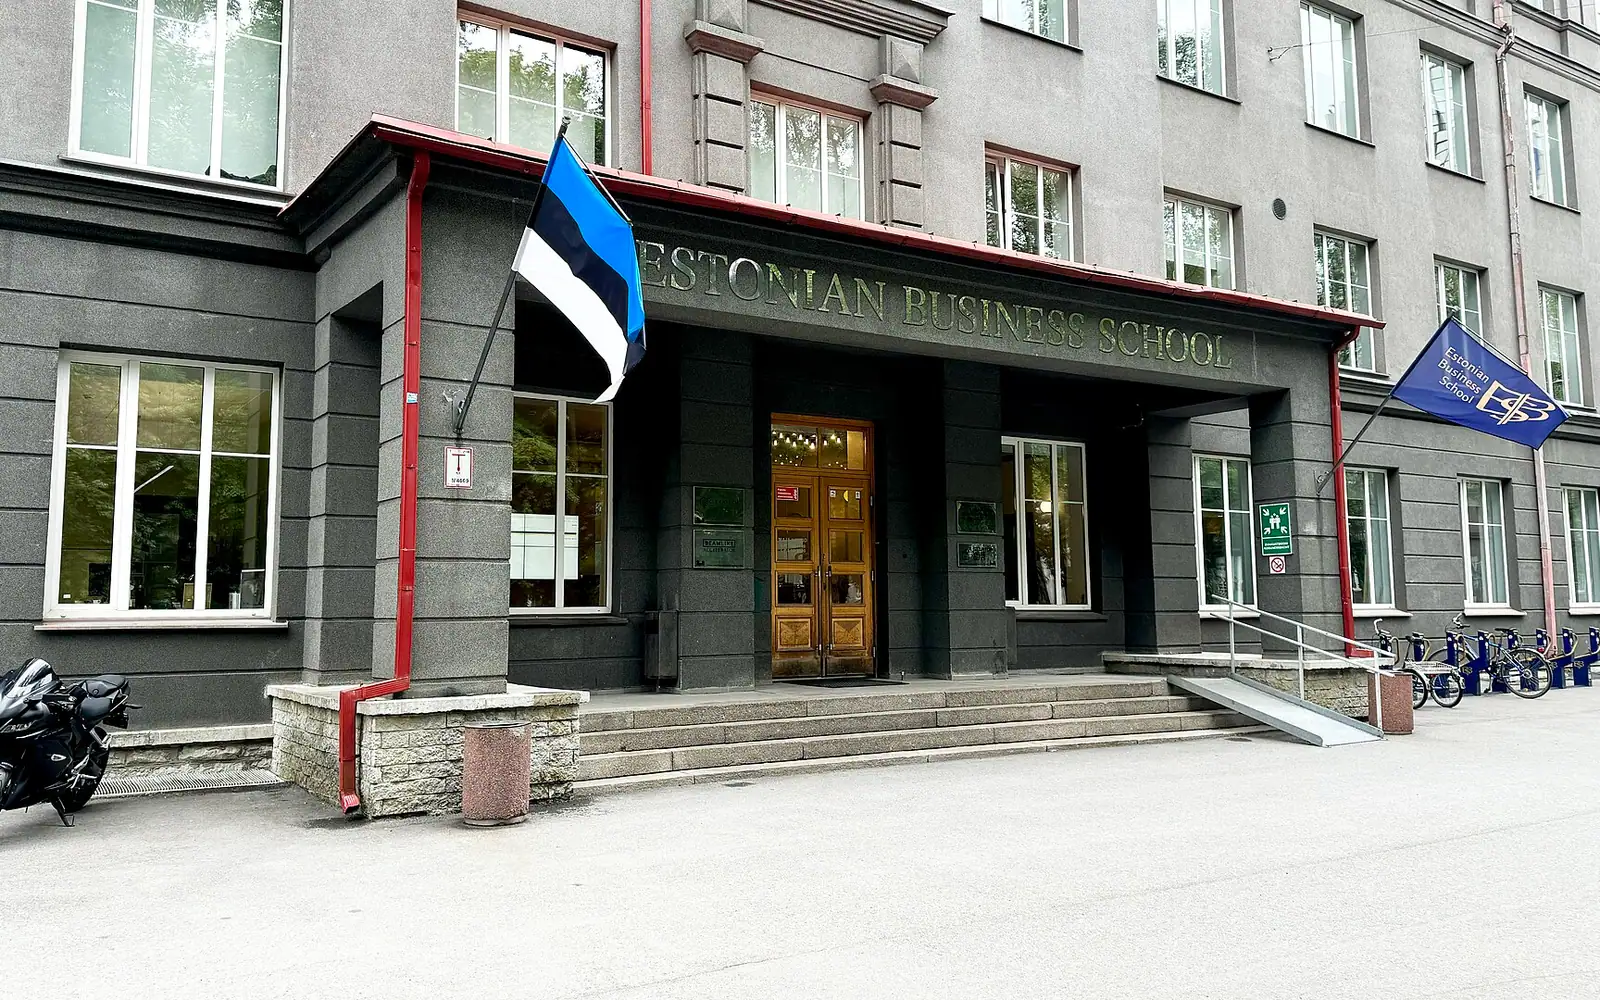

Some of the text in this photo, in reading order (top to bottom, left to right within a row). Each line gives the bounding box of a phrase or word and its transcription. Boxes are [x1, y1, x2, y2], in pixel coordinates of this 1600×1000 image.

[635, 239, 1233, 370] ESTONIAN BUSINESS SCHOOL
[1437, 358, 1482, 394] Business
[1444, 346, 1490, 384] Estonian
[1438, 376, 1475, 404] School
